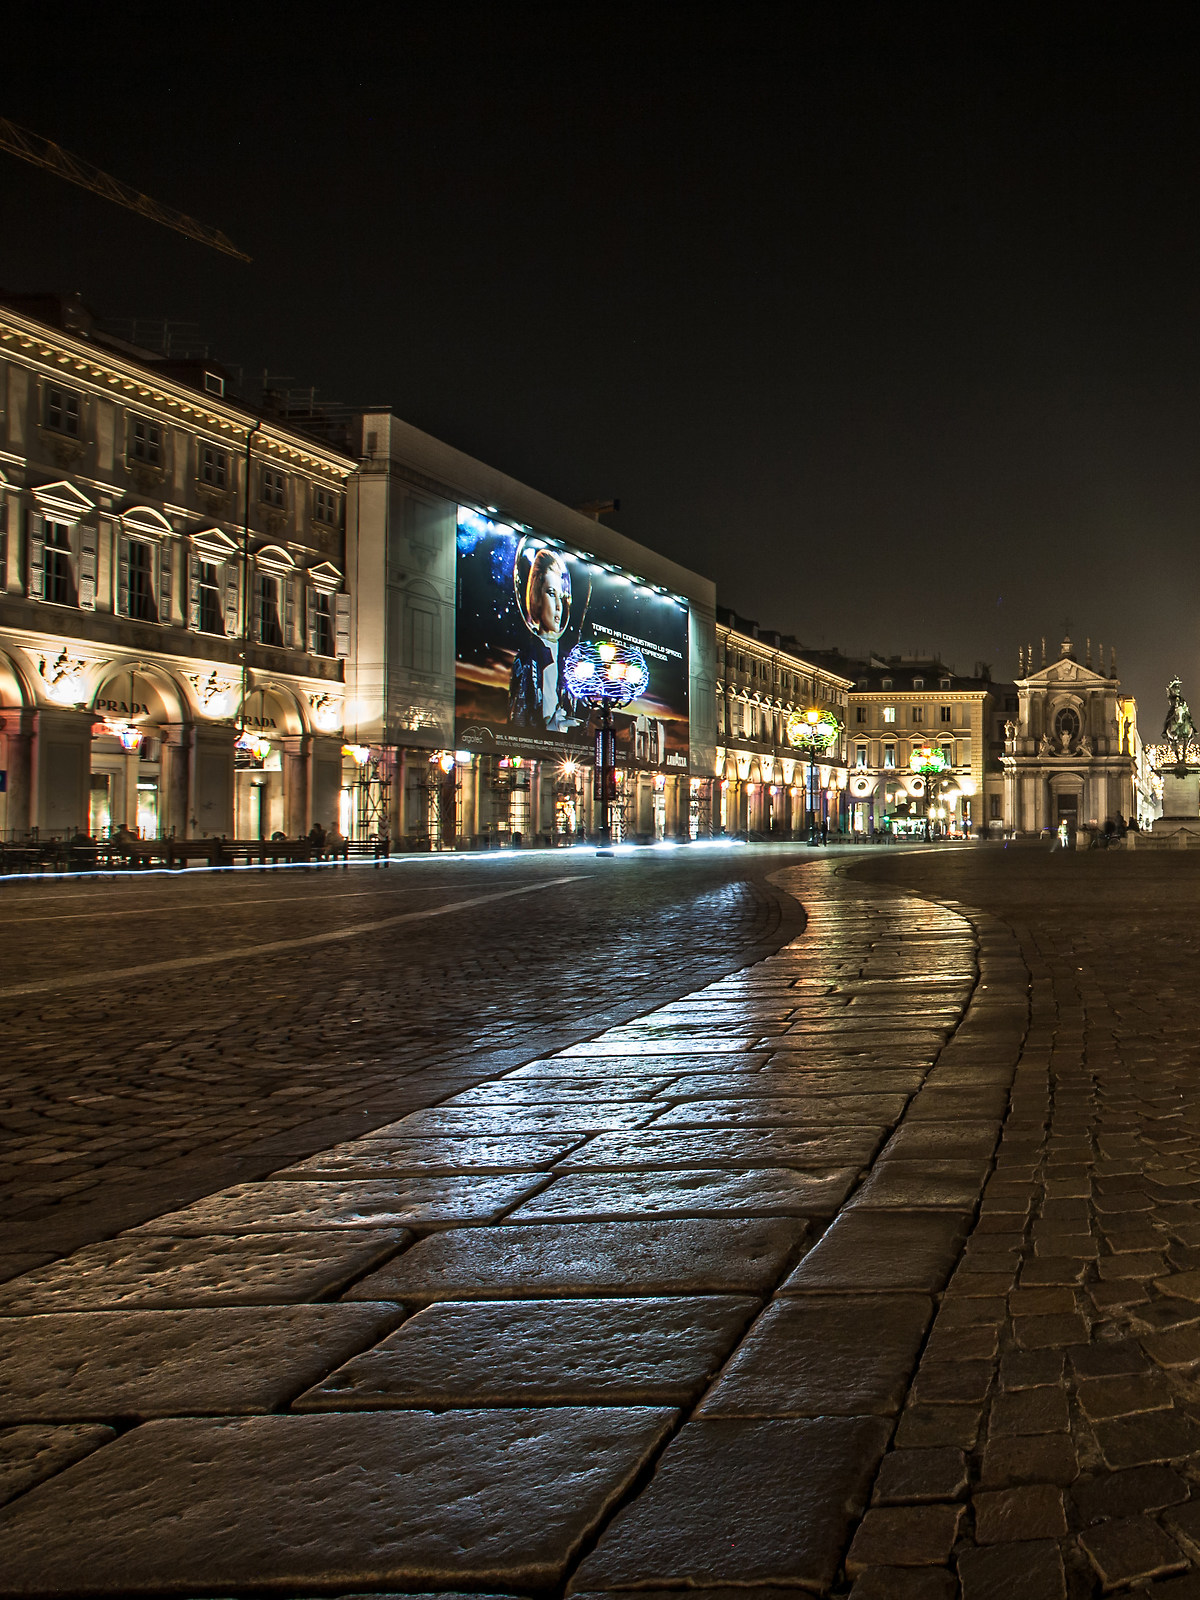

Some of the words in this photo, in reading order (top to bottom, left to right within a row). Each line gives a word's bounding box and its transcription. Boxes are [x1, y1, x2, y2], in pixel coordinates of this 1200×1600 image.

[592, 622, 613, 636] TORINO
[613, 630, 622, 639] HA
[96, 699, 151, 716] PRADA
